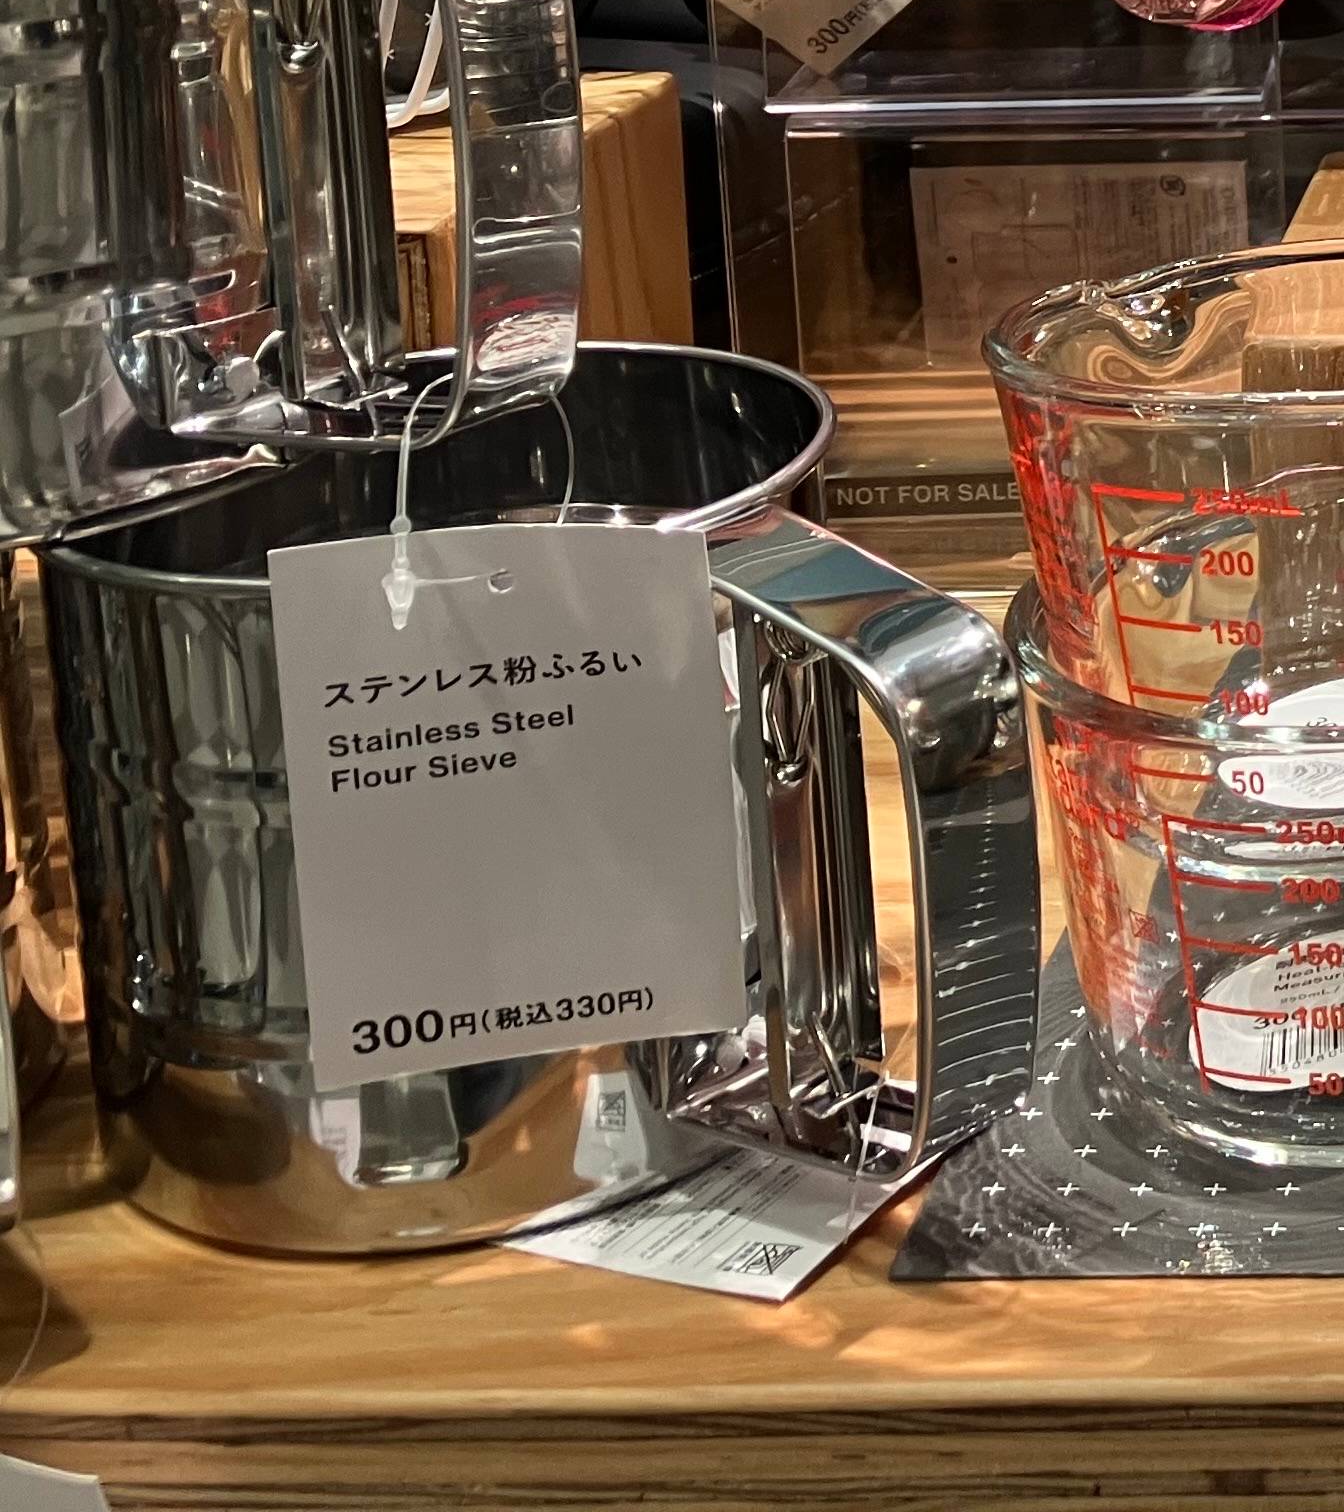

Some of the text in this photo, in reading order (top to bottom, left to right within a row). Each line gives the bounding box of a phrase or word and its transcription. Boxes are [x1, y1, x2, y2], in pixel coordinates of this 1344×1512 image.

[837, 482, 1021, 505] NOT FOR SALE
[1201, 550, 1254, 576] 200
[1210, 619, 1263, 646] 150
[323, 648, 642, 708] ステンレス粉ふるい
[1220, 690, 1270, 716] 100
[328, 704, 575, 758] Stainless Steel
[330, 748, 518, 793] Flour Sieve
[1232, 770, 1265, 796] 50
[1281, 878, 1343, 905] 200
[1289, 943, 1344, 967] 150
[351, 986, 654, 1056] 300円(税込330円)
[1308, 1073, 1344, 1096] 50
